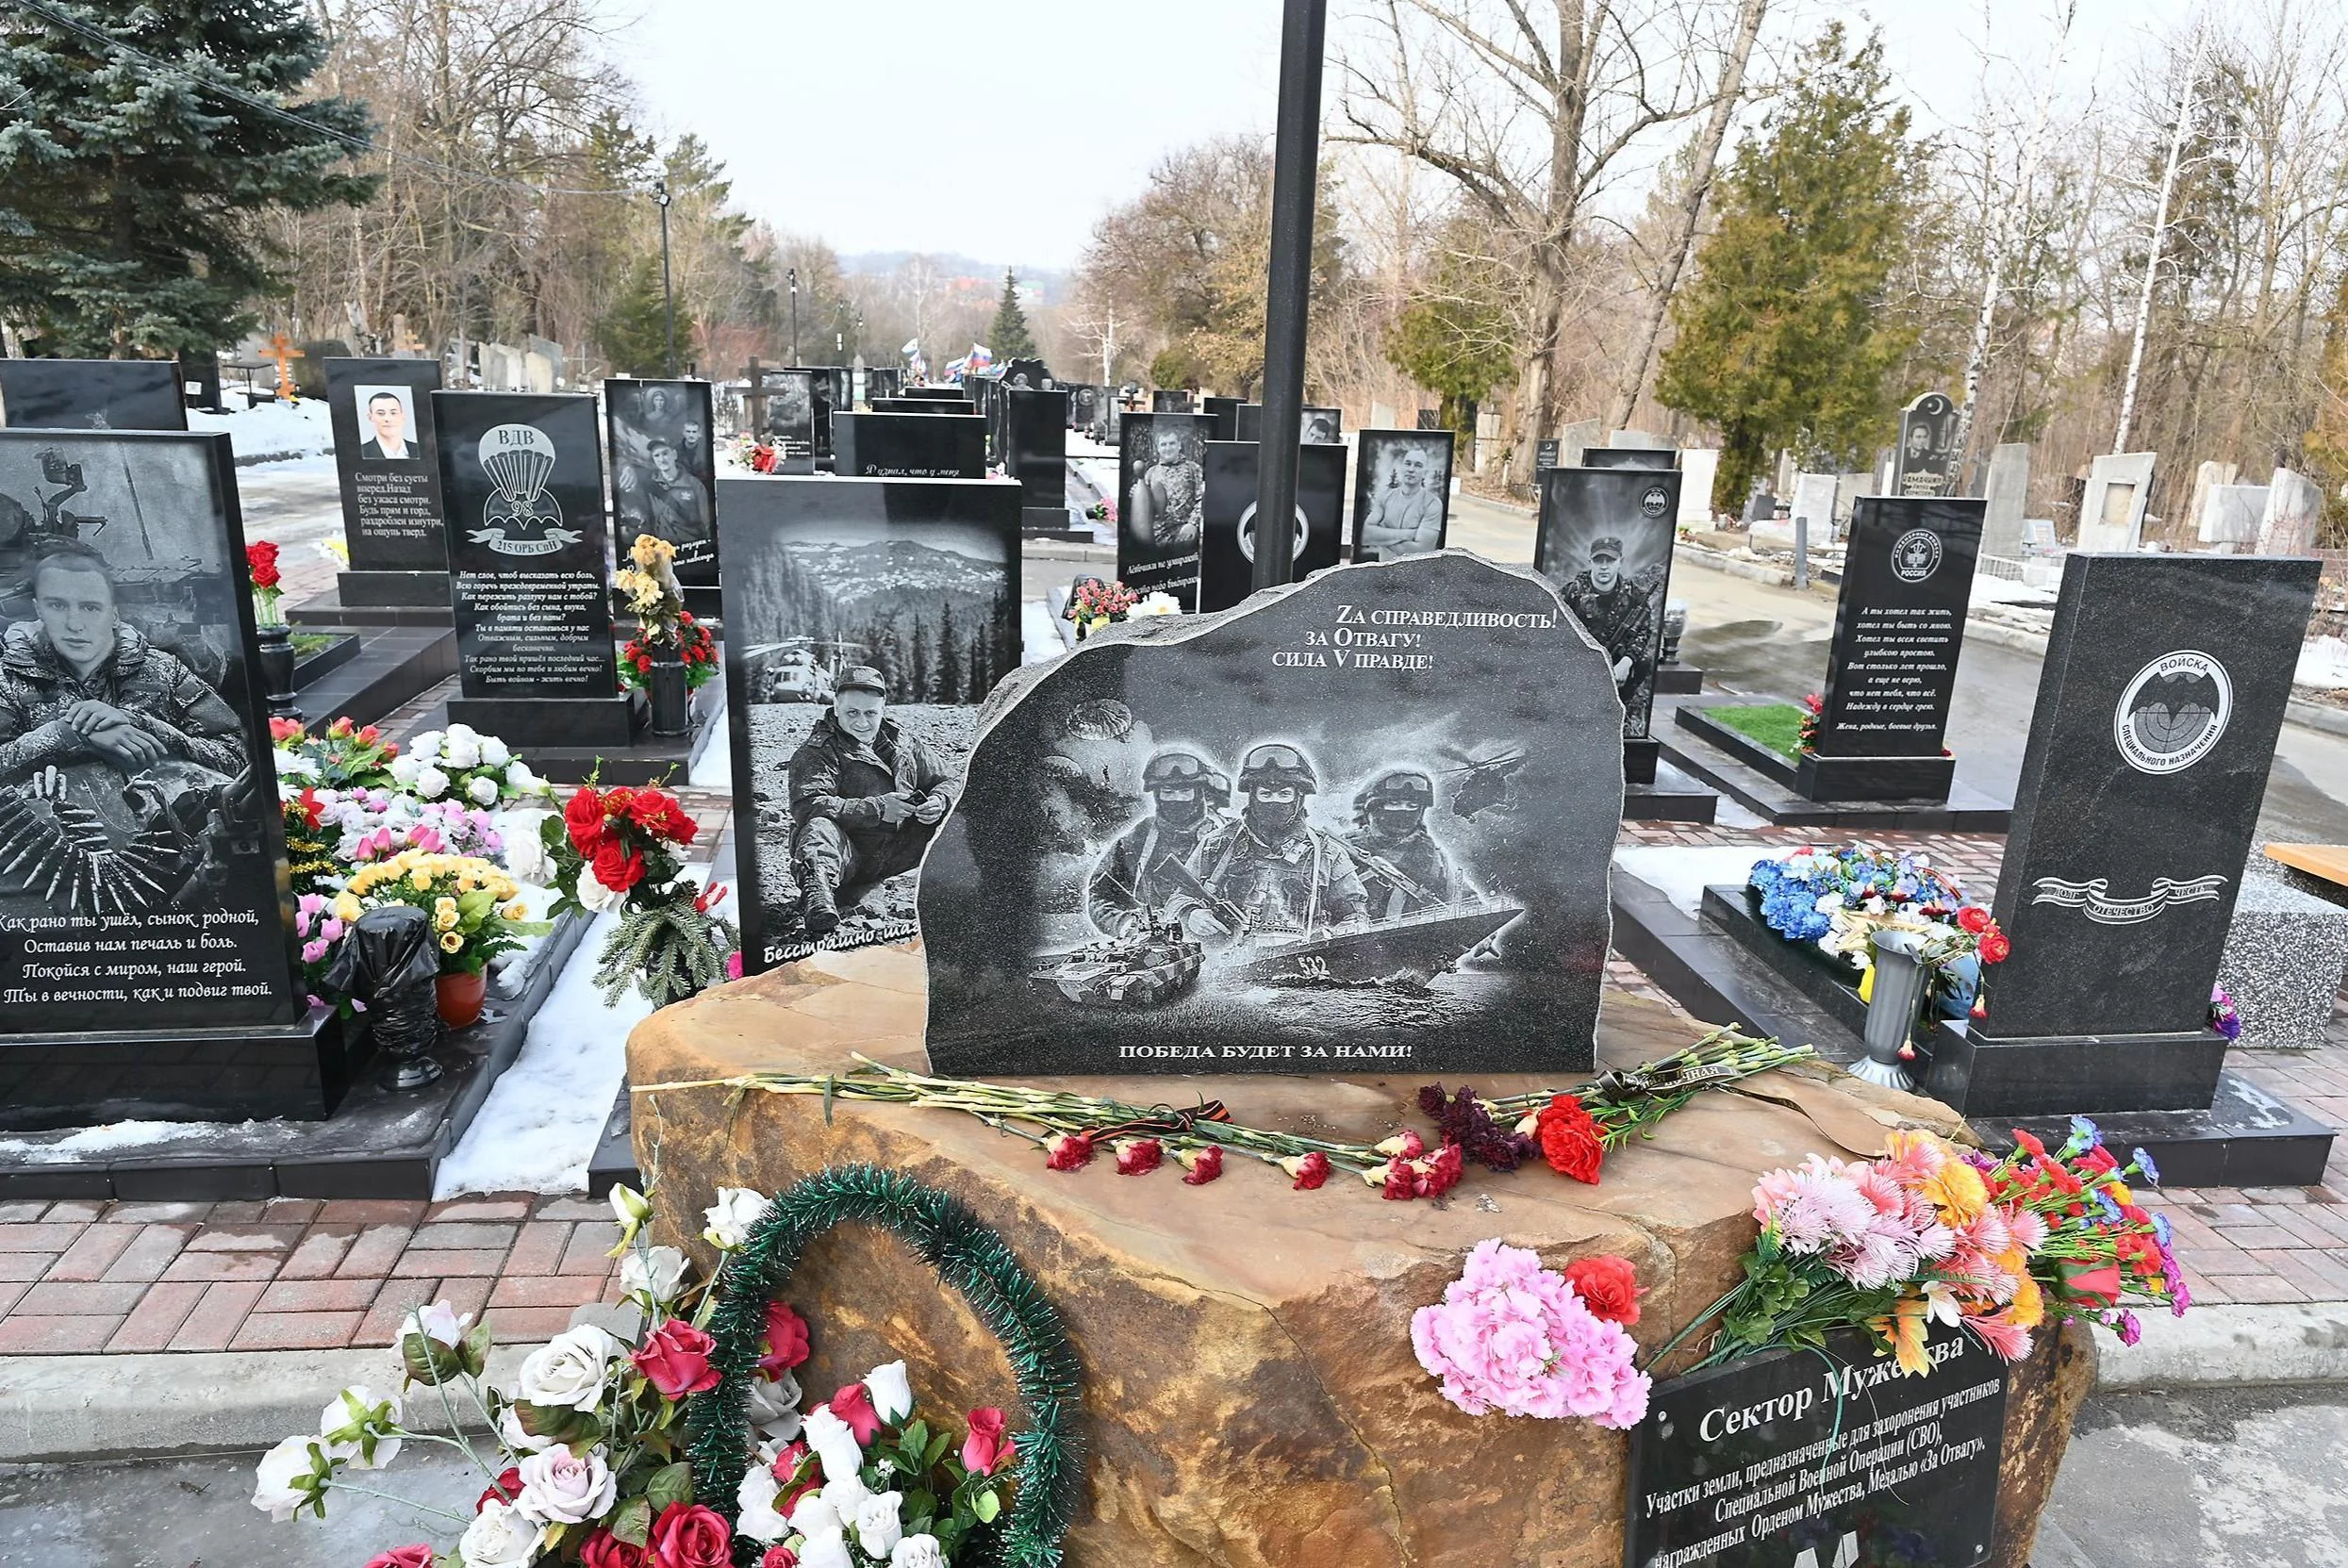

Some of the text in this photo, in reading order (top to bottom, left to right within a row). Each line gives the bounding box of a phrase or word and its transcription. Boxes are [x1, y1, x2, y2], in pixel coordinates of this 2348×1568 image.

[499, 430, 534, 446] ВДВ
[356, 472, 428, 485] Смотри без суеты
[358, 494, 372, 503] без
[372, 497, 398, 505] ужаса
[359, 505, 378, 516] Будь
[381, 507, 401, 516] прям
[511, 501, 534, 517] 98
[361, 516, 406, 527] раздроблен
[373, 529, 400, 537] ощупь
[498, 541, 512, 551] 215
[515, 543, 534, 553] ОРБ
[1895, 533, 1928, 558] ИНЖЕНЕРНЫЕ
[497, 614, 521, 623] брата
[1370, 608, 1557, 630] СПРАВЕДЛИВОСТЬ!
[1305, 628, 1421, 648] ЗА ОТВАГУ!
[1272, 650, 1434, 671] СИЛА V ПРАВДЕ!
[1863, 649, 1898, 658] улыбкою
[2159, 656, 2208, 672] ВОЙСКА
[1845, 701, 1881, 712] Надежду
[1889, 702, 1914, 712] сердце
[2122, 724, 2218, 766] СПЕЦИАЛЬНОГО НАЗНАЧЕНИЯ
[2054, 888, 2080, 900] ДОЛГ
[2174, 886, 2206, 897] ЧЕСТЬ
[2093, 903, 2154, 916] ОТЕЧЕСТВО
[0, 915, 31, 932] Как
[29, 916, 66, 933] рано
[71, 916, 97, 928] ты
[100, 914, 141, 932] ушёл,
[202, 909, 259, 930] родной,
[25, 933, 237, 953] Оставив нам печаль и боль.
[763, 931, 875, 964] Бесстрашно
[23, 958, 246, 981] Покойся с миром, наш герой.
[1297, 955, 1331, 979] 532
[4, 982, 273, 1003] Ты в вечности, как и подвиг твой.
[1118, 1046, 1413, 1060] ПОБЕДА БУДЕТ ЗА НАМИ!
[1699, 1336, 1964, 1444] Сектор Мужева
[1645, 1377, 2000, 1519] Участки земли, предназначенные для захоронения участников
[1714, 1421, 1943, 1524] Специальной Военной Операции (СВО),
[1654, 1524, 1745, 1568] награжденных
[1751, 1504, 1804, 1543] Орденом
[1806, 1482, 1866, 1520] Мужества,
[1867, 1460, 1919, 1495] Медалью
[1919, 1449, 1939, 1473] «За
